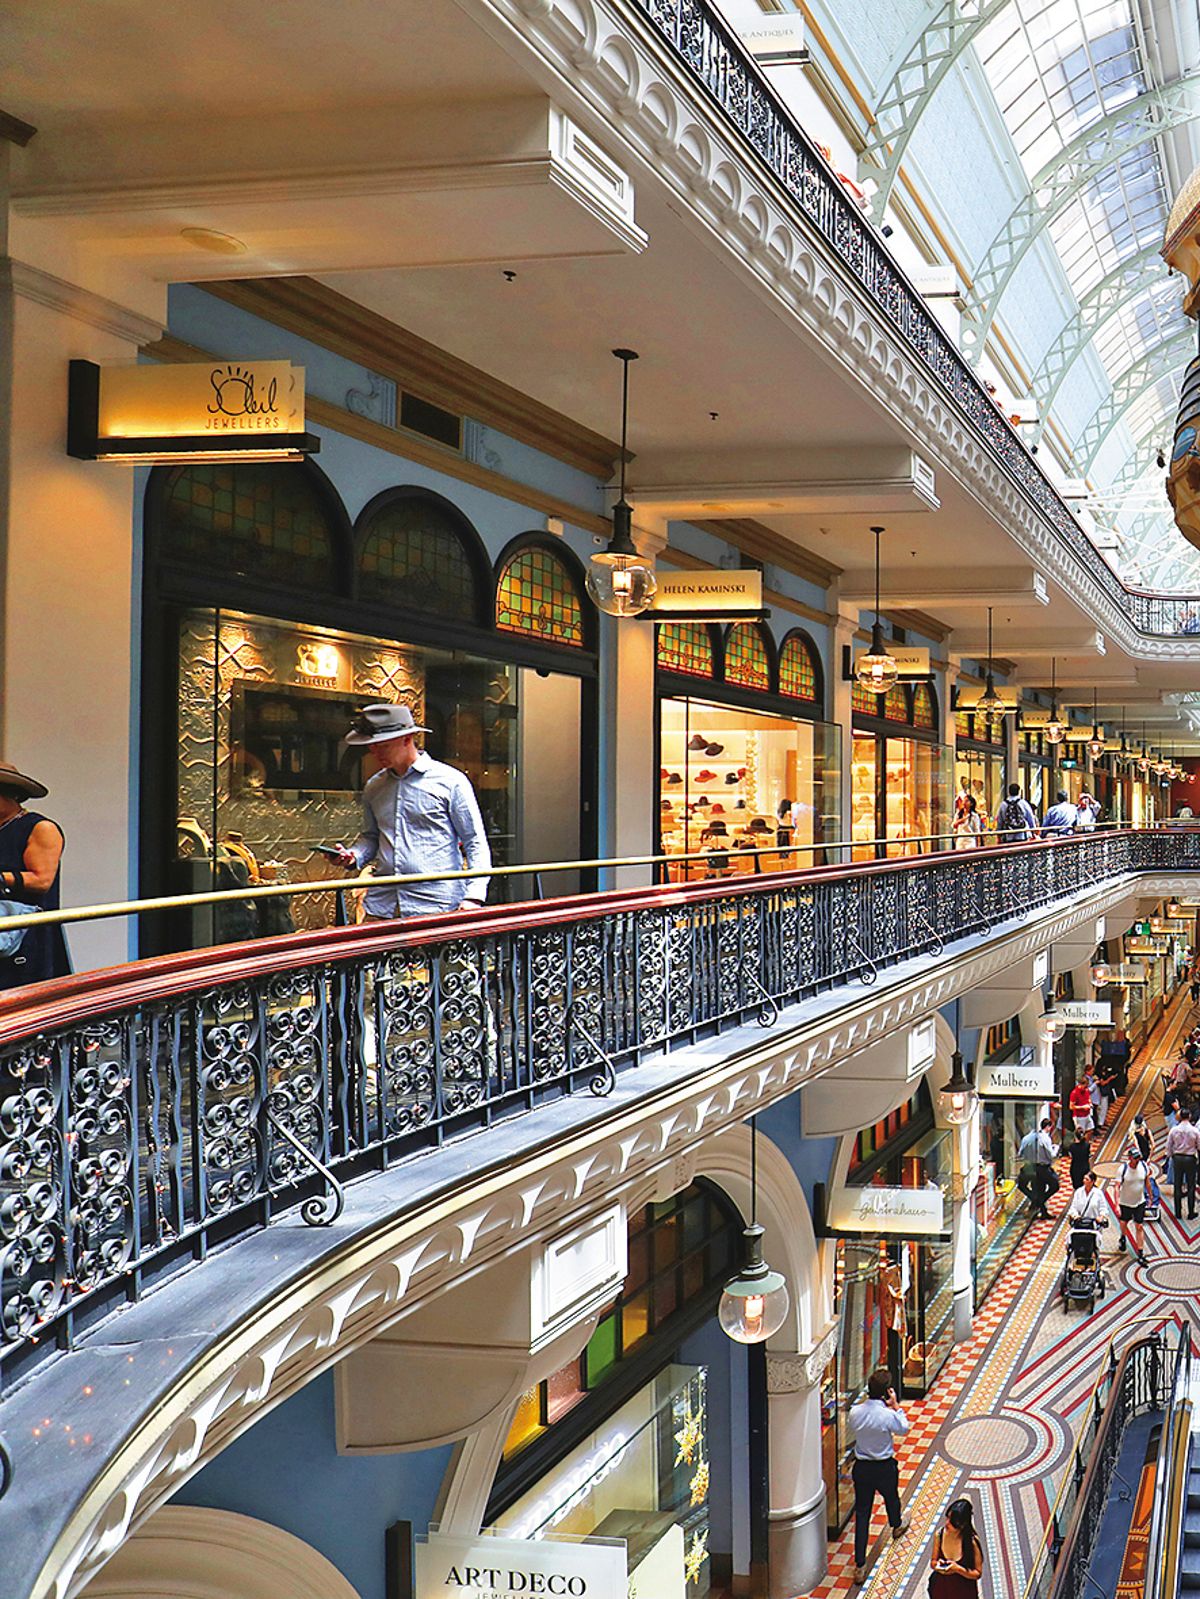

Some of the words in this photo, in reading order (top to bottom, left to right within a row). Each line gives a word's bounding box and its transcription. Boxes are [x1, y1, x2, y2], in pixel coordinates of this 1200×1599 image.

[205, 417, 280, 429] JEWELLERS
[664, 585, 696, 594] HELEN
[698, 584, 746, 593] KAMINSKI
[1062, 1007, 1100, 1020] Mulberry
[990, 1073, 1039, 1090] Mulberry
[445, 1565, 502, 1589] ART
[507, 1570, 587, 1597] DECO
